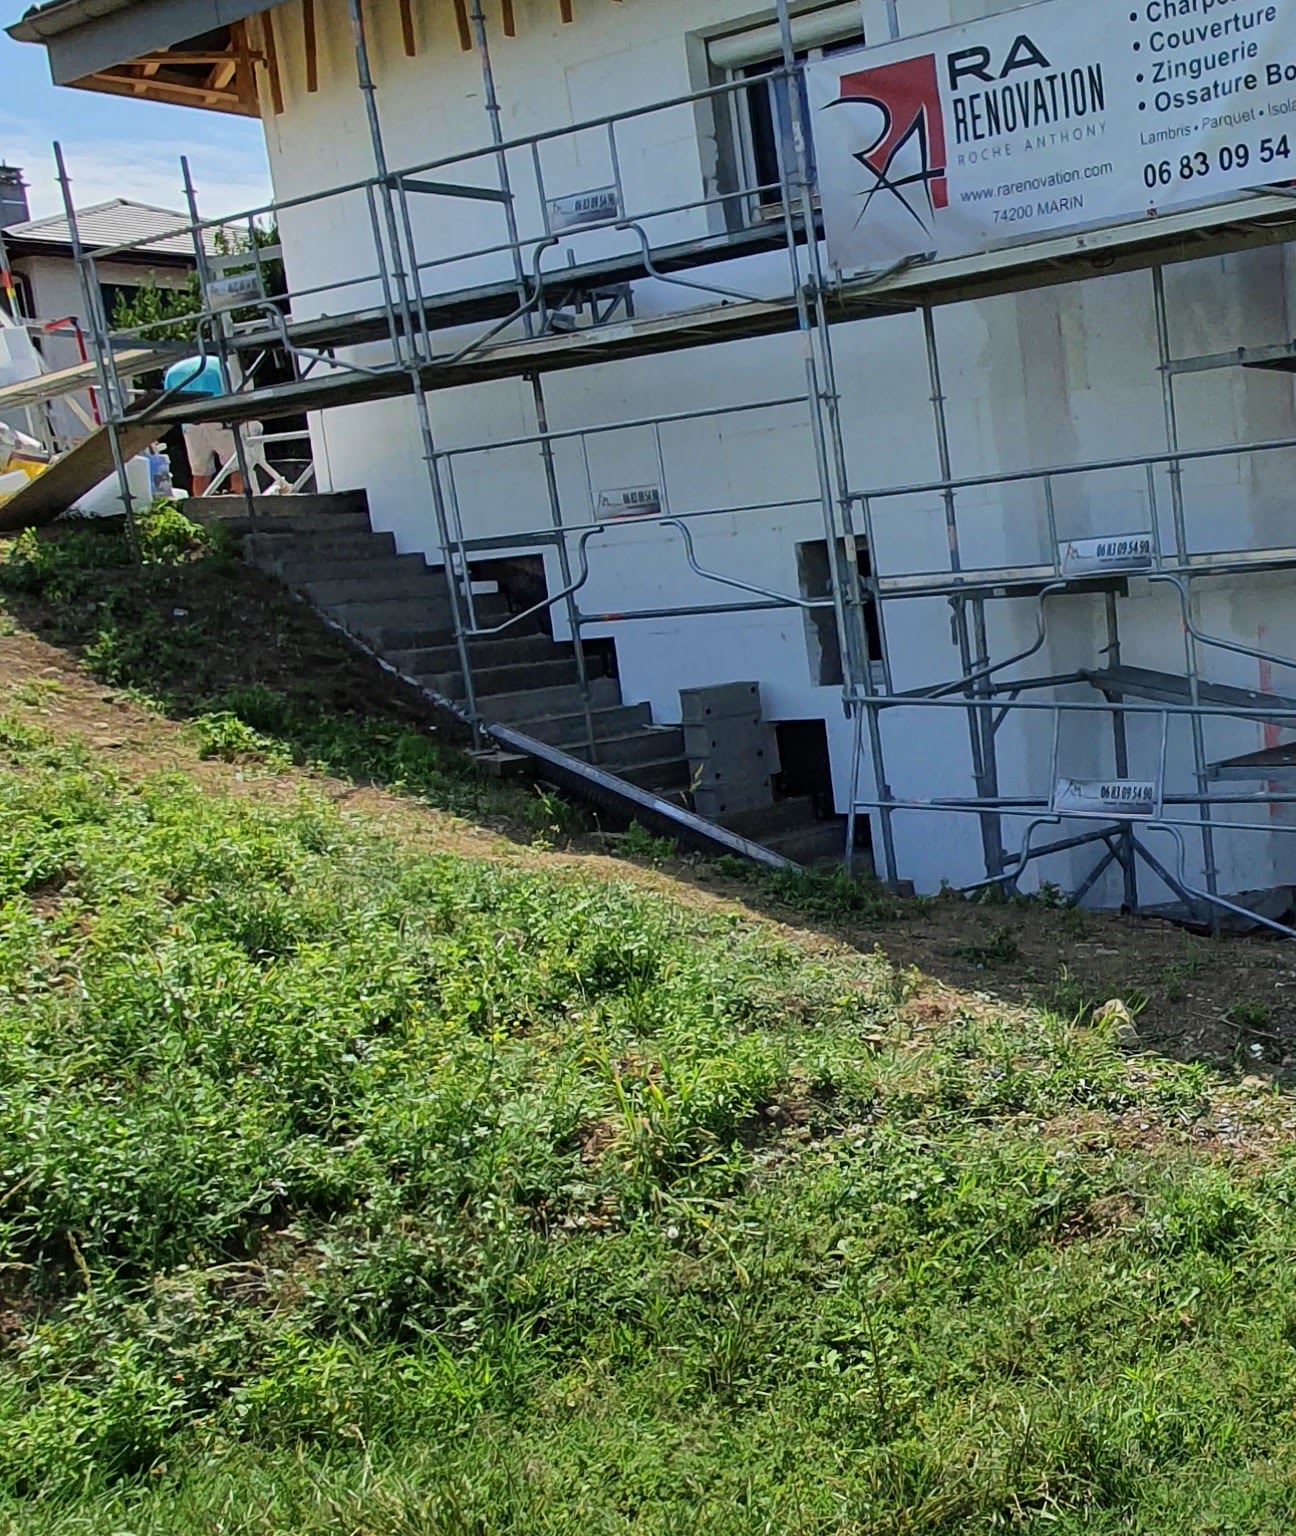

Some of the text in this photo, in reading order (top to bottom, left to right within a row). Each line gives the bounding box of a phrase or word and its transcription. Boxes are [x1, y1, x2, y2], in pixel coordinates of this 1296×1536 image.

[1149, 5, 1277, 53] Couverture
[947, 34, 1052, 91] RA
[1151, 41, 1259, 84] Zinguerie
[952, 63, 1106, 145] RENOVATION
[1154, 72, 1258, 113] Ossature
[957, 121, 1108, 166] ROCHE ANTHONY
[1139, 124, 1192, 146] Lambris
[1201, 109, 1256, 132] Parquet
[959, 161, 1114, 203] www.rarenovation.com
[1143, 160, 1173, 189] 06
[1179, 151, 1211, 180] 83
[1218, 143, 1250, 171] 09
[1259, 134, 1291, 163] 54
[992, 194, 1084, 224] 74200 MARIN
